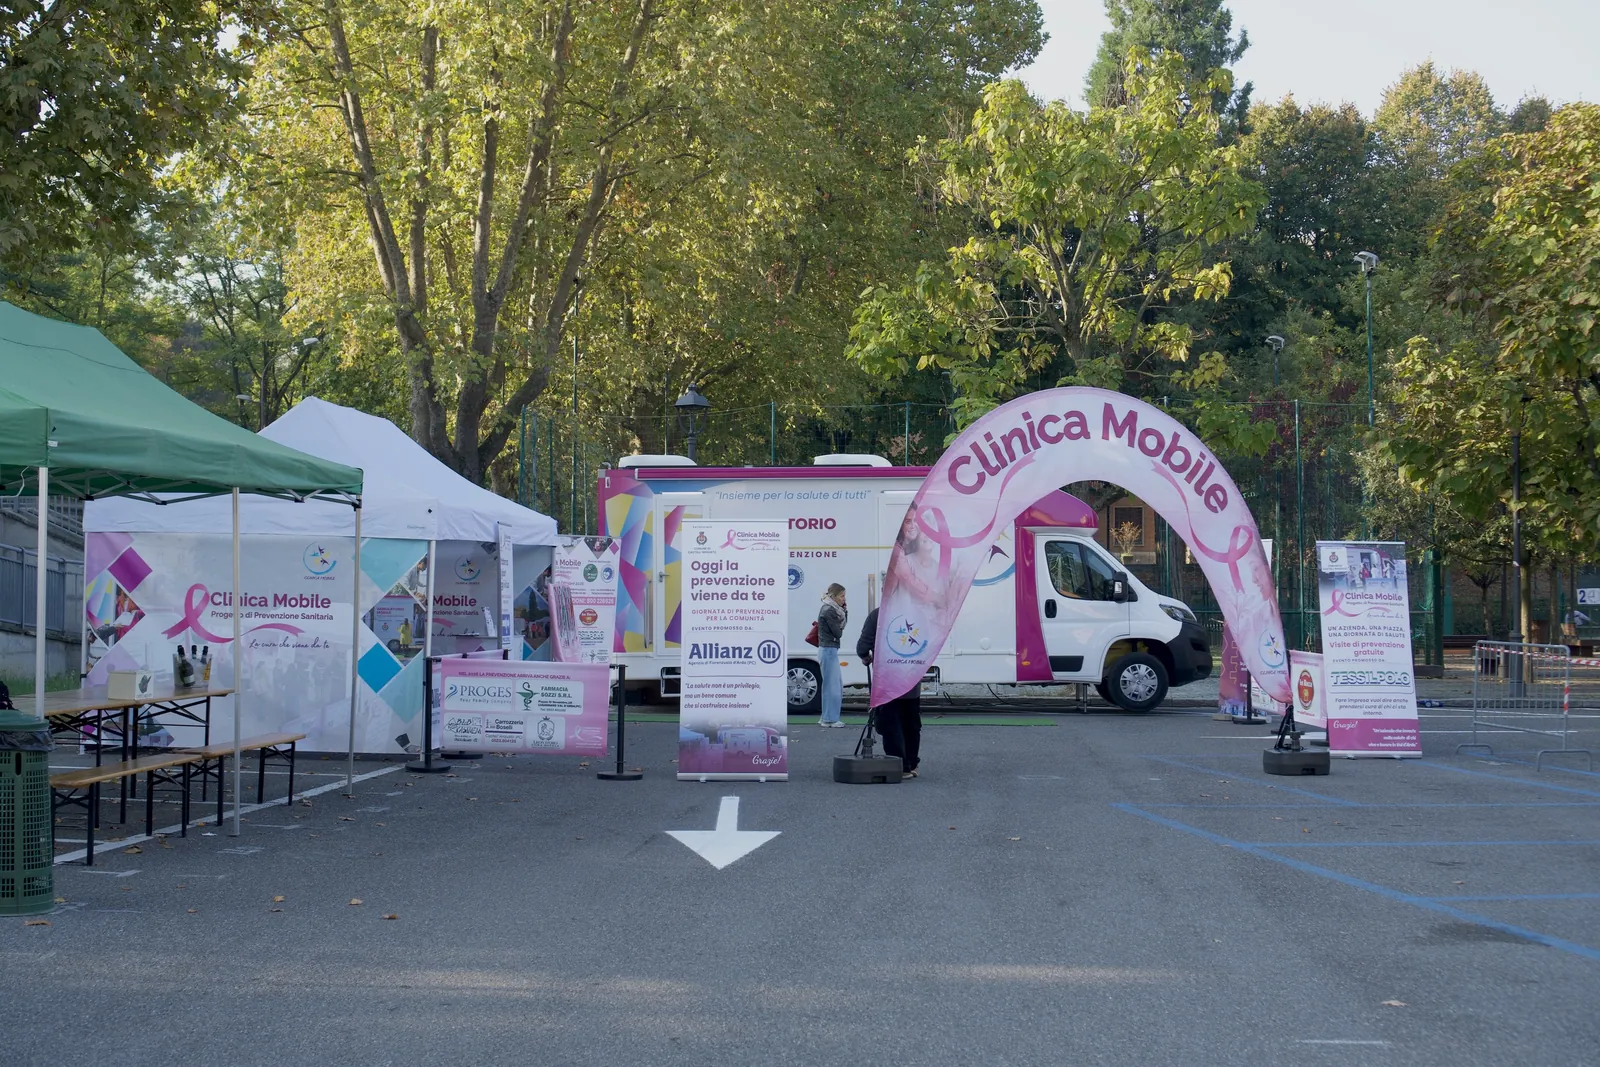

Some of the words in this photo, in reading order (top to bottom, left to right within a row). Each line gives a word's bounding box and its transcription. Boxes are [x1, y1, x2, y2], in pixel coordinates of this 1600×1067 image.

[948, 410, 1090, 495] Clinica
[1102, 402, 1228, 514] Mobile
[762, 492, 781, 502] per
[784, 491, 794, 500] la
[796, 490, 829, 500] salute
[832, 490, 842, 500] di
[788, 518, 836, 530] TORIO
[737, 531, 758, 539] Clinica
[759, 531, 781, 539] Mobile
[560, 559, 582, 567] Mobile
[691, 560, 723, 574] Oggi
[726, 560, 738, 571] la
[692, 575, 775, 589] prevenzione
[274, 593, 331, 609] Mobile
[433, 595, 477, 607] Mobile
[691, 590, 728, 601] viene
[731, 590, 748, 601] da
[752, 591, 765, 601] te
[1345, 592, 1374, 600] Clinica
[1376, 593, 1402, 602] Mobile
[211, 611, 244, 620] Progeo
[245, 611, 252, 619] di
[254, 612, 299, 620] Prevenzione
[301, 613, 334, 621] Sanitaria
[279, 636, 290, 648] che
[292, 641, 310, 649] viene
[311, 637, 322, 649] da
[1362, 642, 1404, 650] prevenzione
[689, 643, 753, 660] Allianz
[460, 685, 512, 698] PROGES
[1334, 720, 1358, 731] Grazie!
[752, 755, 782, 767] Grazie!
